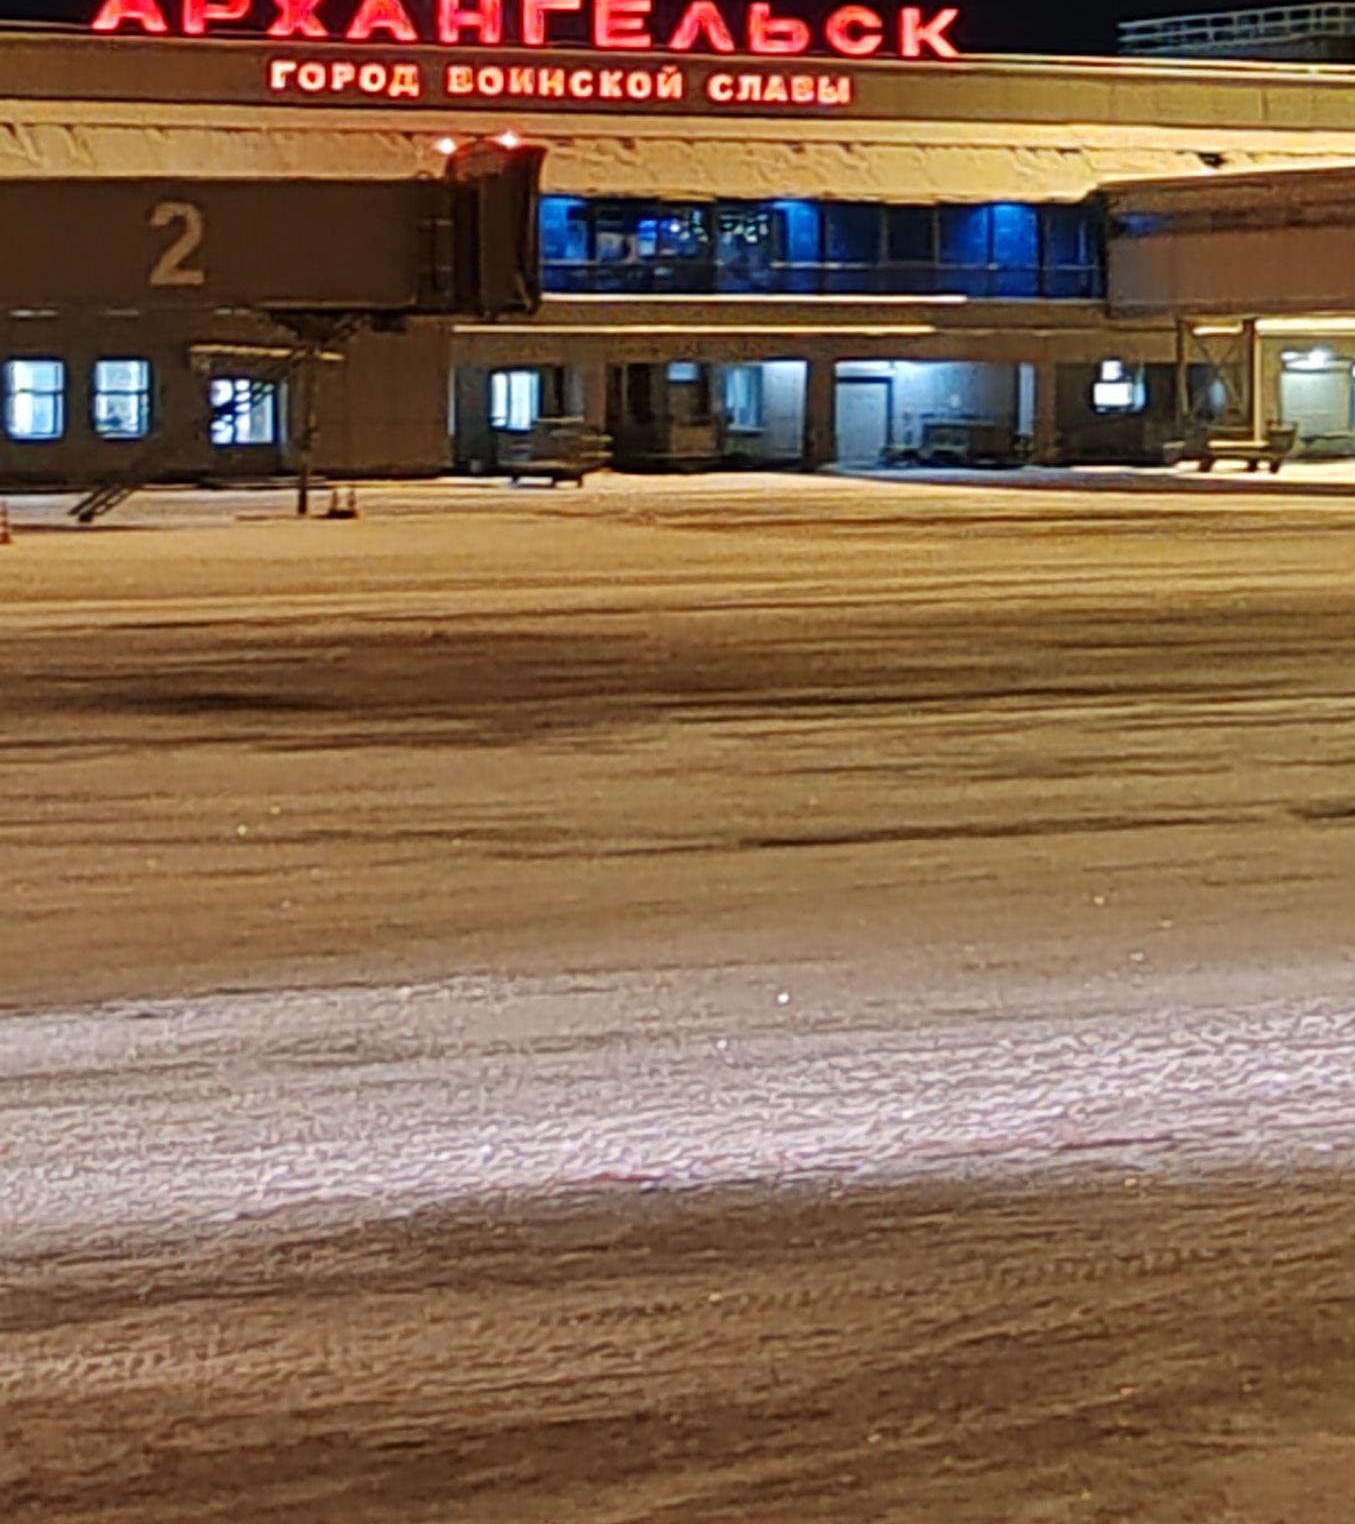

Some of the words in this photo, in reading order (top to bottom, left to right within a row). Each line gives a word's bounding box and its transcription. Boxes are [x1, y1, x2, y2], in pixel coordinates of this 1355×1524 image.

[269, 59, 420, 97] ГОРОД
[446, 64, 684, 99] ВОИНСКОЙ
[706, 74, 852, 104] СЛАВЫ
[150, 202, 204, 285] 2
